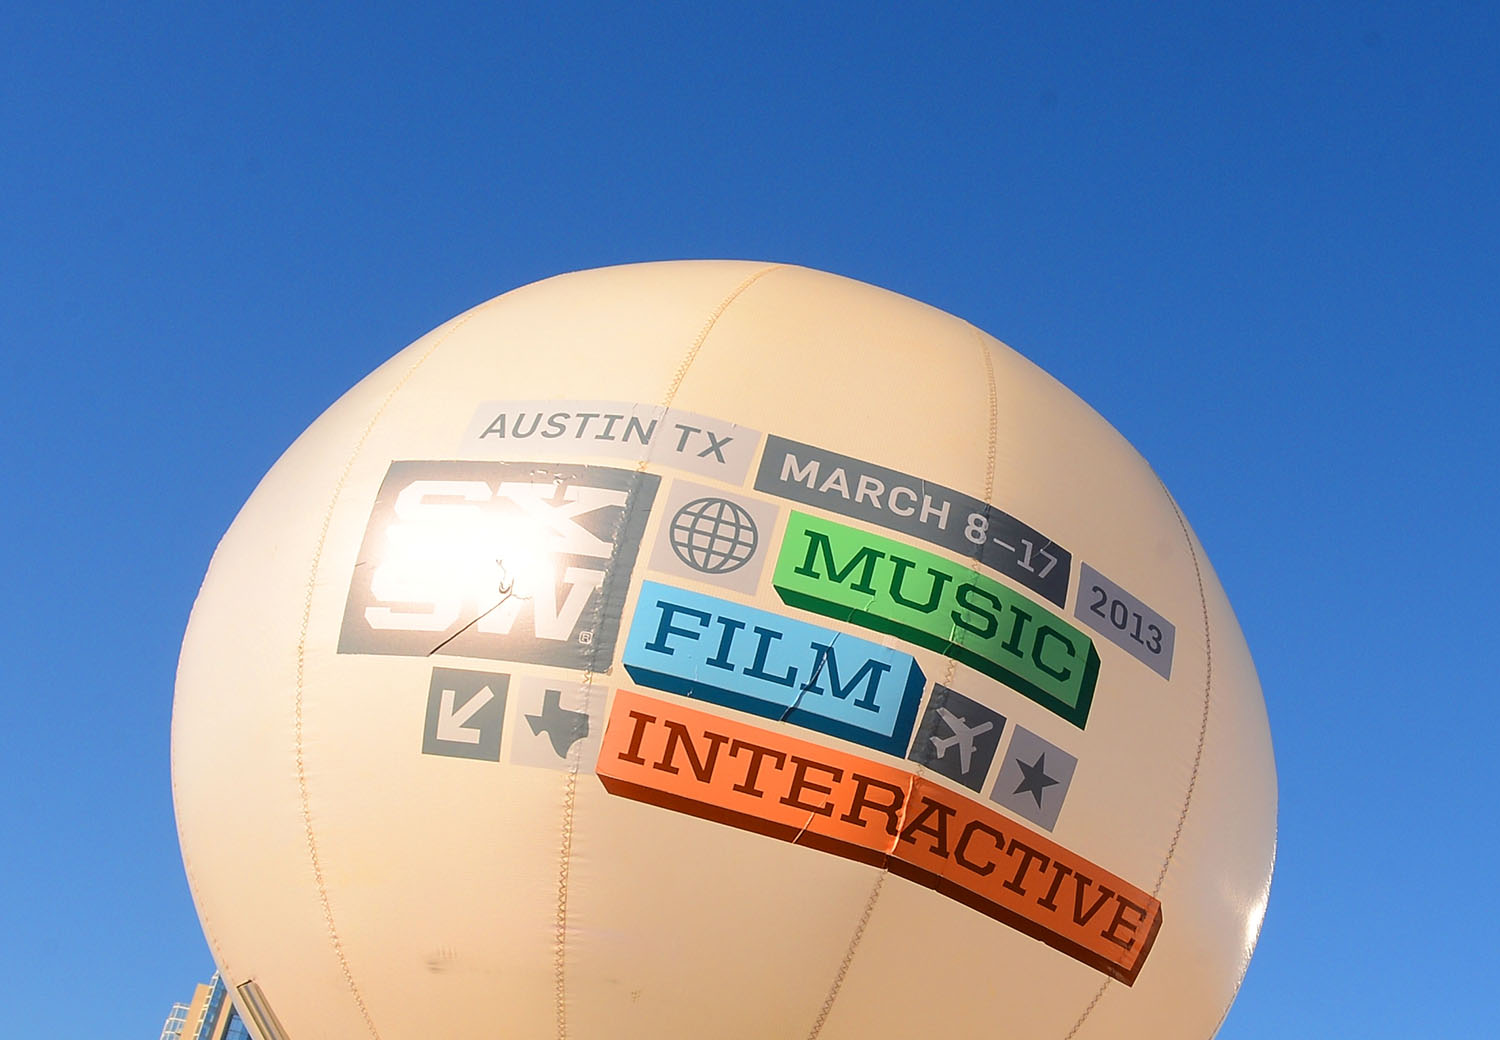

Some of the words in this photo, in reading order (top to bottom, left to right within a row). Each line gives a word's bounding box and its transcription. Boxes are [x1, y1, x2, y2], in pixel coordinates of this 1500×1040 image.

[479, 412, 658, 445] AUSTIN
[674, 424, 733, 464] TX
[780, 453, 951, 530] MARCH
[794, 530, 1076, 682] MUSIC
[1089, 585, 1163, 656] 2013
[645, 600, 891, 713] FILM
[618, 710, 1149, 952] INTERACTIVE
